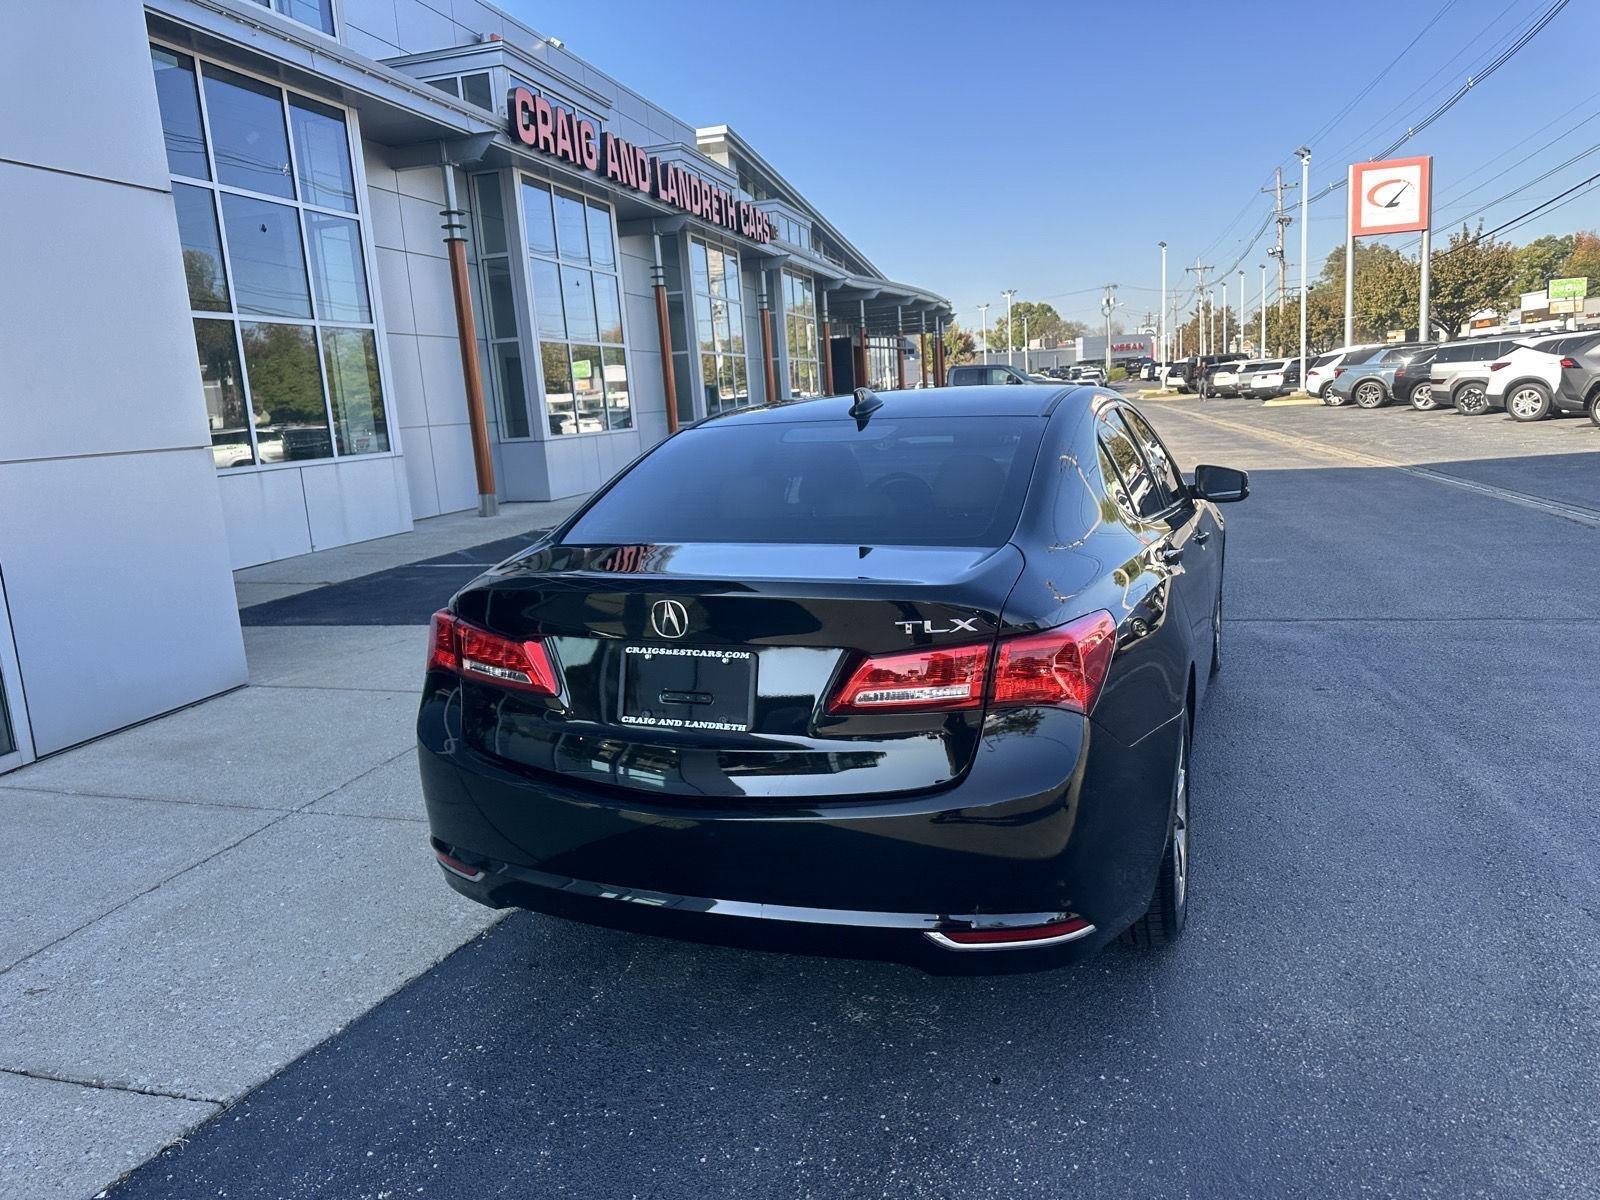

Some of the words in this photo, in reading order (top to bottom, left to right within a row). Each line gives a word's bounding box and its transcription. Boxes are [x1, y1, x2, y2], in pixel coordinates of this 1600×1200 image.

[511, 87, 598, 171] CRAIG
[602, 131, 650, 193] AND
[654, 157, 737, 232] LANDRETH
[739, 200, 770, 244] CARS
[1110, 342, 1144, 352] NISSAN
[894, 617, 978, 634] TLX
[621, 715, 656, 725] CRAIG
[658, 718, 682, 727] AND
[684, 720, 747, 732] LANDRETH
